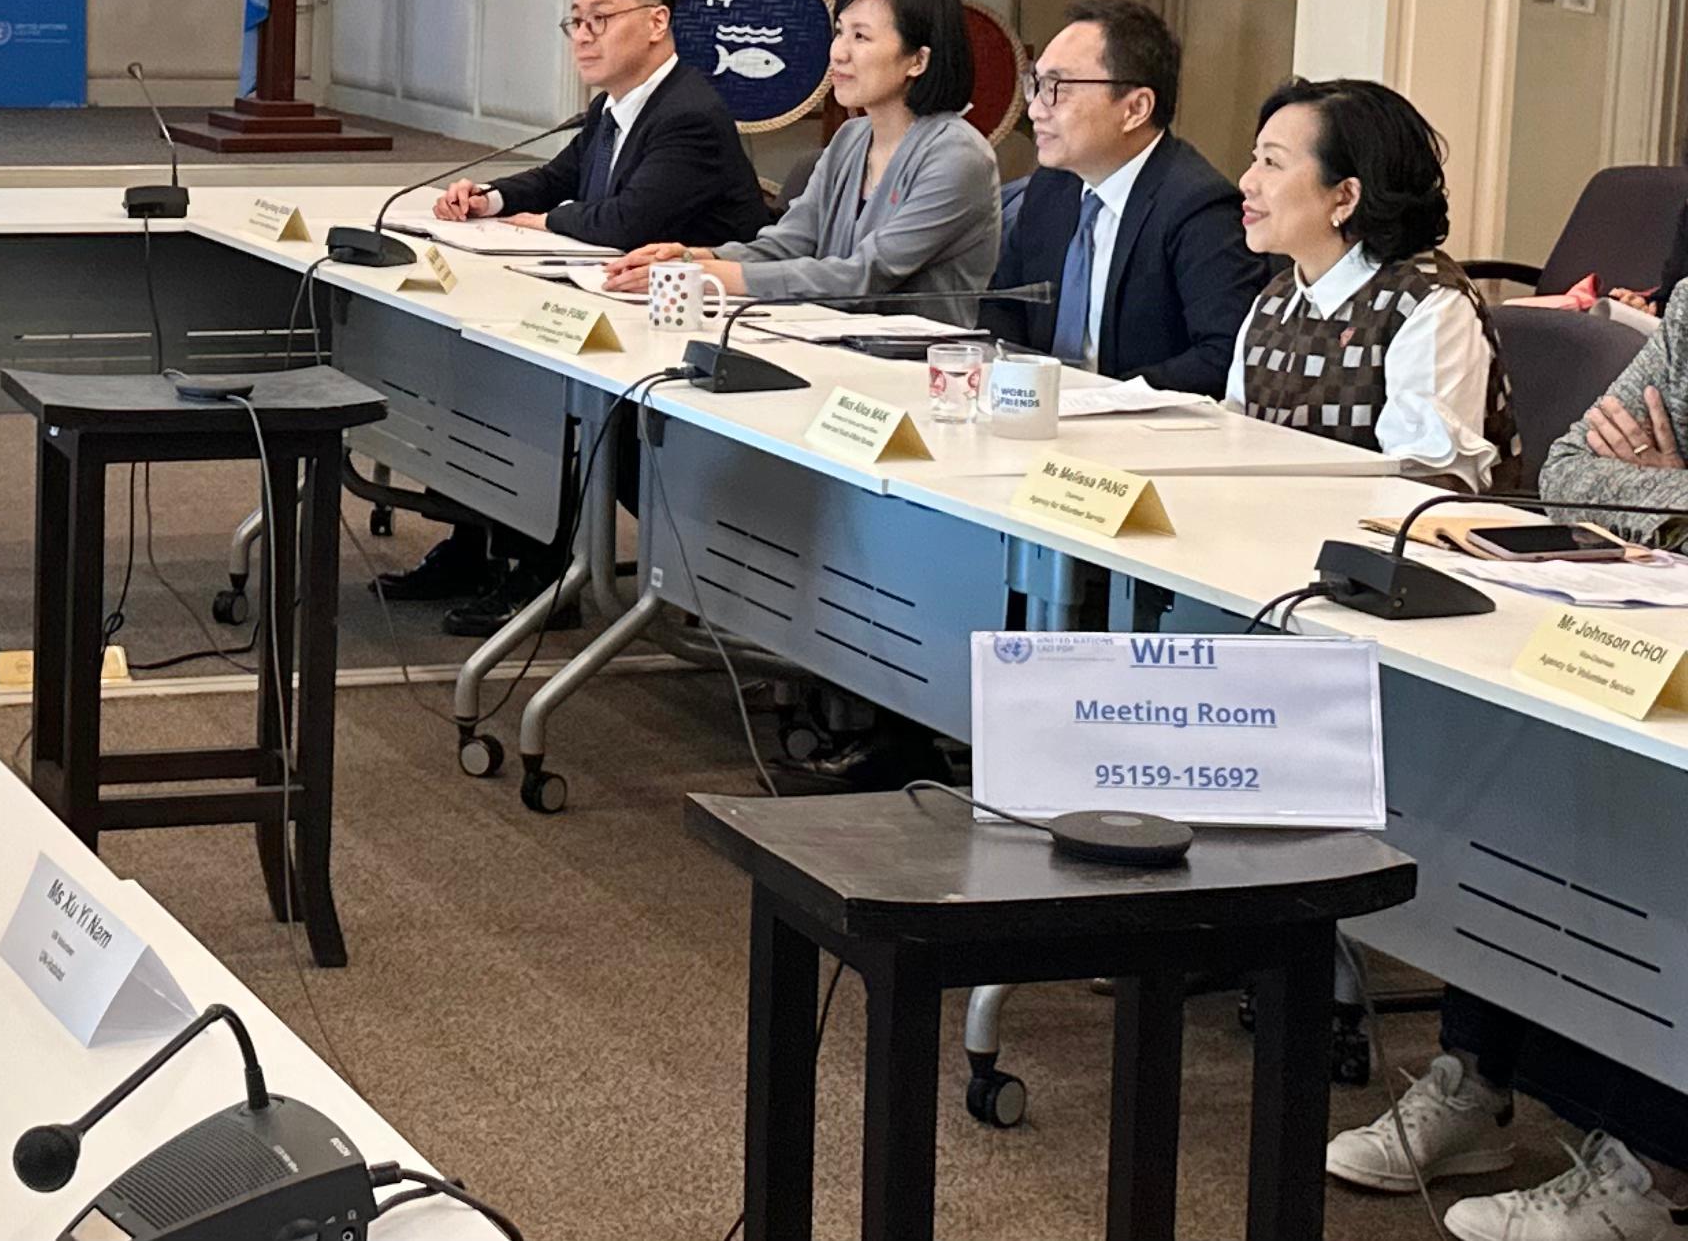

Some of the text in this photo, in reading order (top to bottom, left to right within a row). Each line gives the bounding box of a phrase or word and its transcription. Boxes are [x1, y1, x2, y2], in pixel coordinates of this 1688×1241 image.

[999, 398, 1040, 408] FRIENDS
[1001, 388, 1036, 397] WORLD
[1042, 461, 1130, 498] Ms Melissa PANG
[1130, 638, 1216, 666] Wi-fi
[1557, 613, 1669, 665] Mr Johnson CHOI
[1539, 652, 1636, 696] Agency for Volunteer Service
[1075, 699, 1277, 728] Meeting Room
[1095, 763, 1260, 789] 95159-15692
[46, 878, 113, 949] Ms Xu Yi Nam
